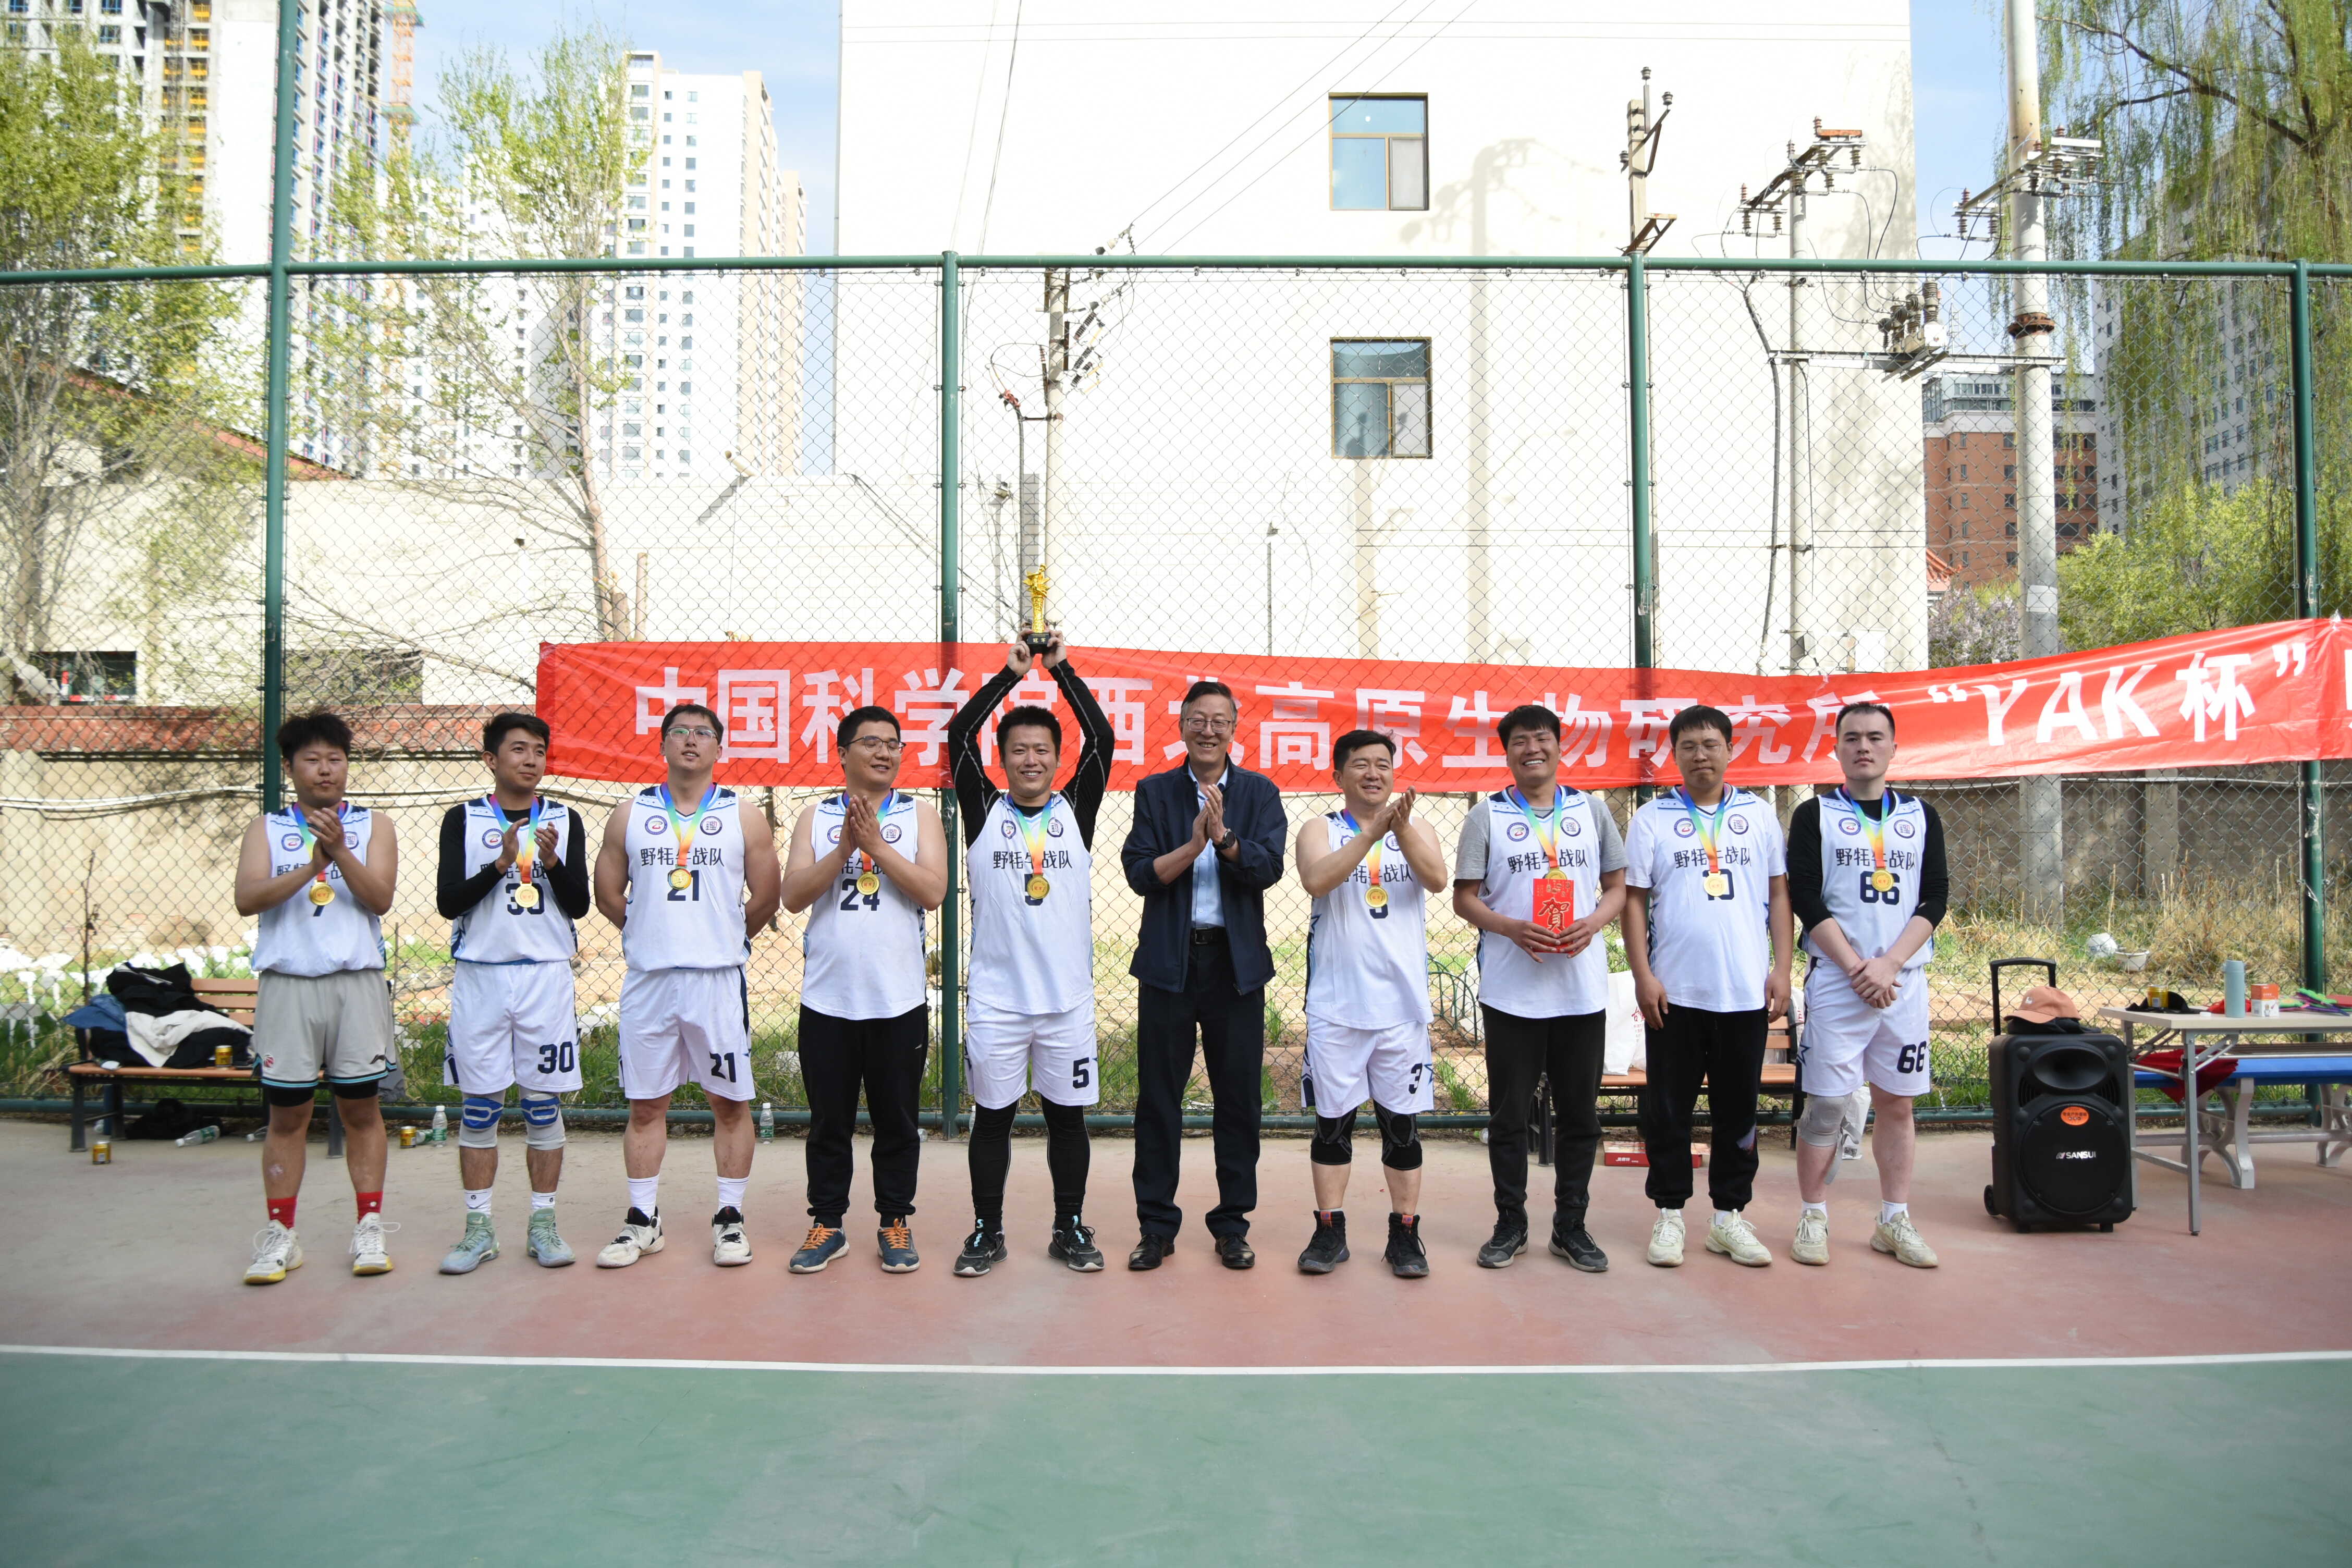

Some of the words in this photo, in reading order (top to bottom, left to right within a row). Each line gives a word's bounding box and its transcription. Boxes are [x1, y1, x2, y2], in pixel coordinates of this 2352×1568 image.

[1835, 848, 1916, 871] 野牦战队
[537, 1041, 575, 1074] 30
[709, 1051, 737, 1083] 21
[1072, 1057, 1090, 1088] 5
[1897, 1040, 1928, 1074] 66
[1407, 1062, 1423, 1095] 3
[2066, 1151, 2097, 1159] SANSUI
